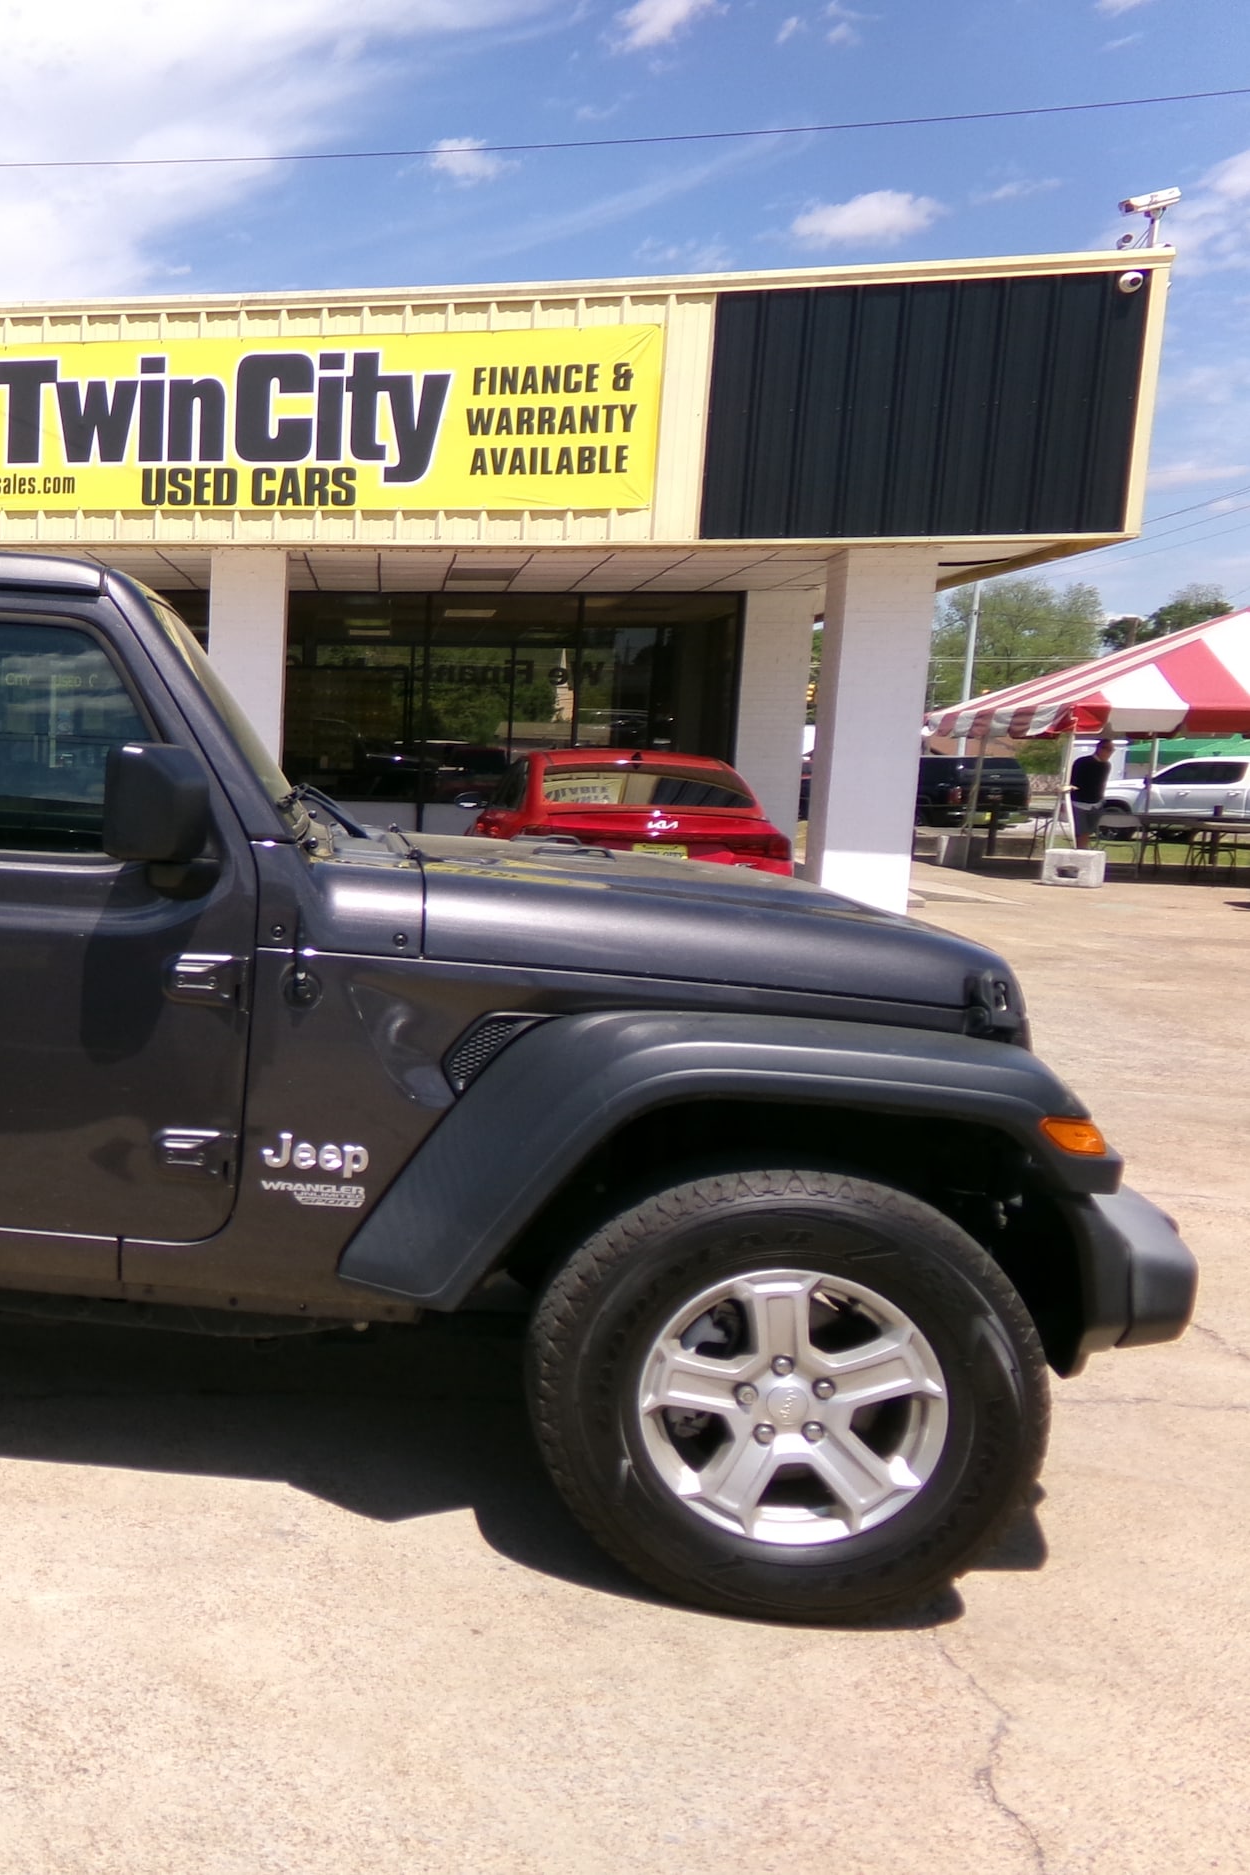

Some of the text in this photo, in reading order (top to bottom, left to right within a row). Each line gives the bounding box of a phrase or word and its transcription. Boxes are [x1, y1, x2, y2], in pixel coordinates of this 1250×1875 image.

[472, 362, 634, 396] FINANCE &
[466, 403, 638, 436] WARRANTY
[469, 445, 629, 476] AVAILABLE
[141, 466, 357, 506] USED CARS
[262, 1132, 370, 1178] Jeep
[261, 1180, 366, 1194] WRANGLER
